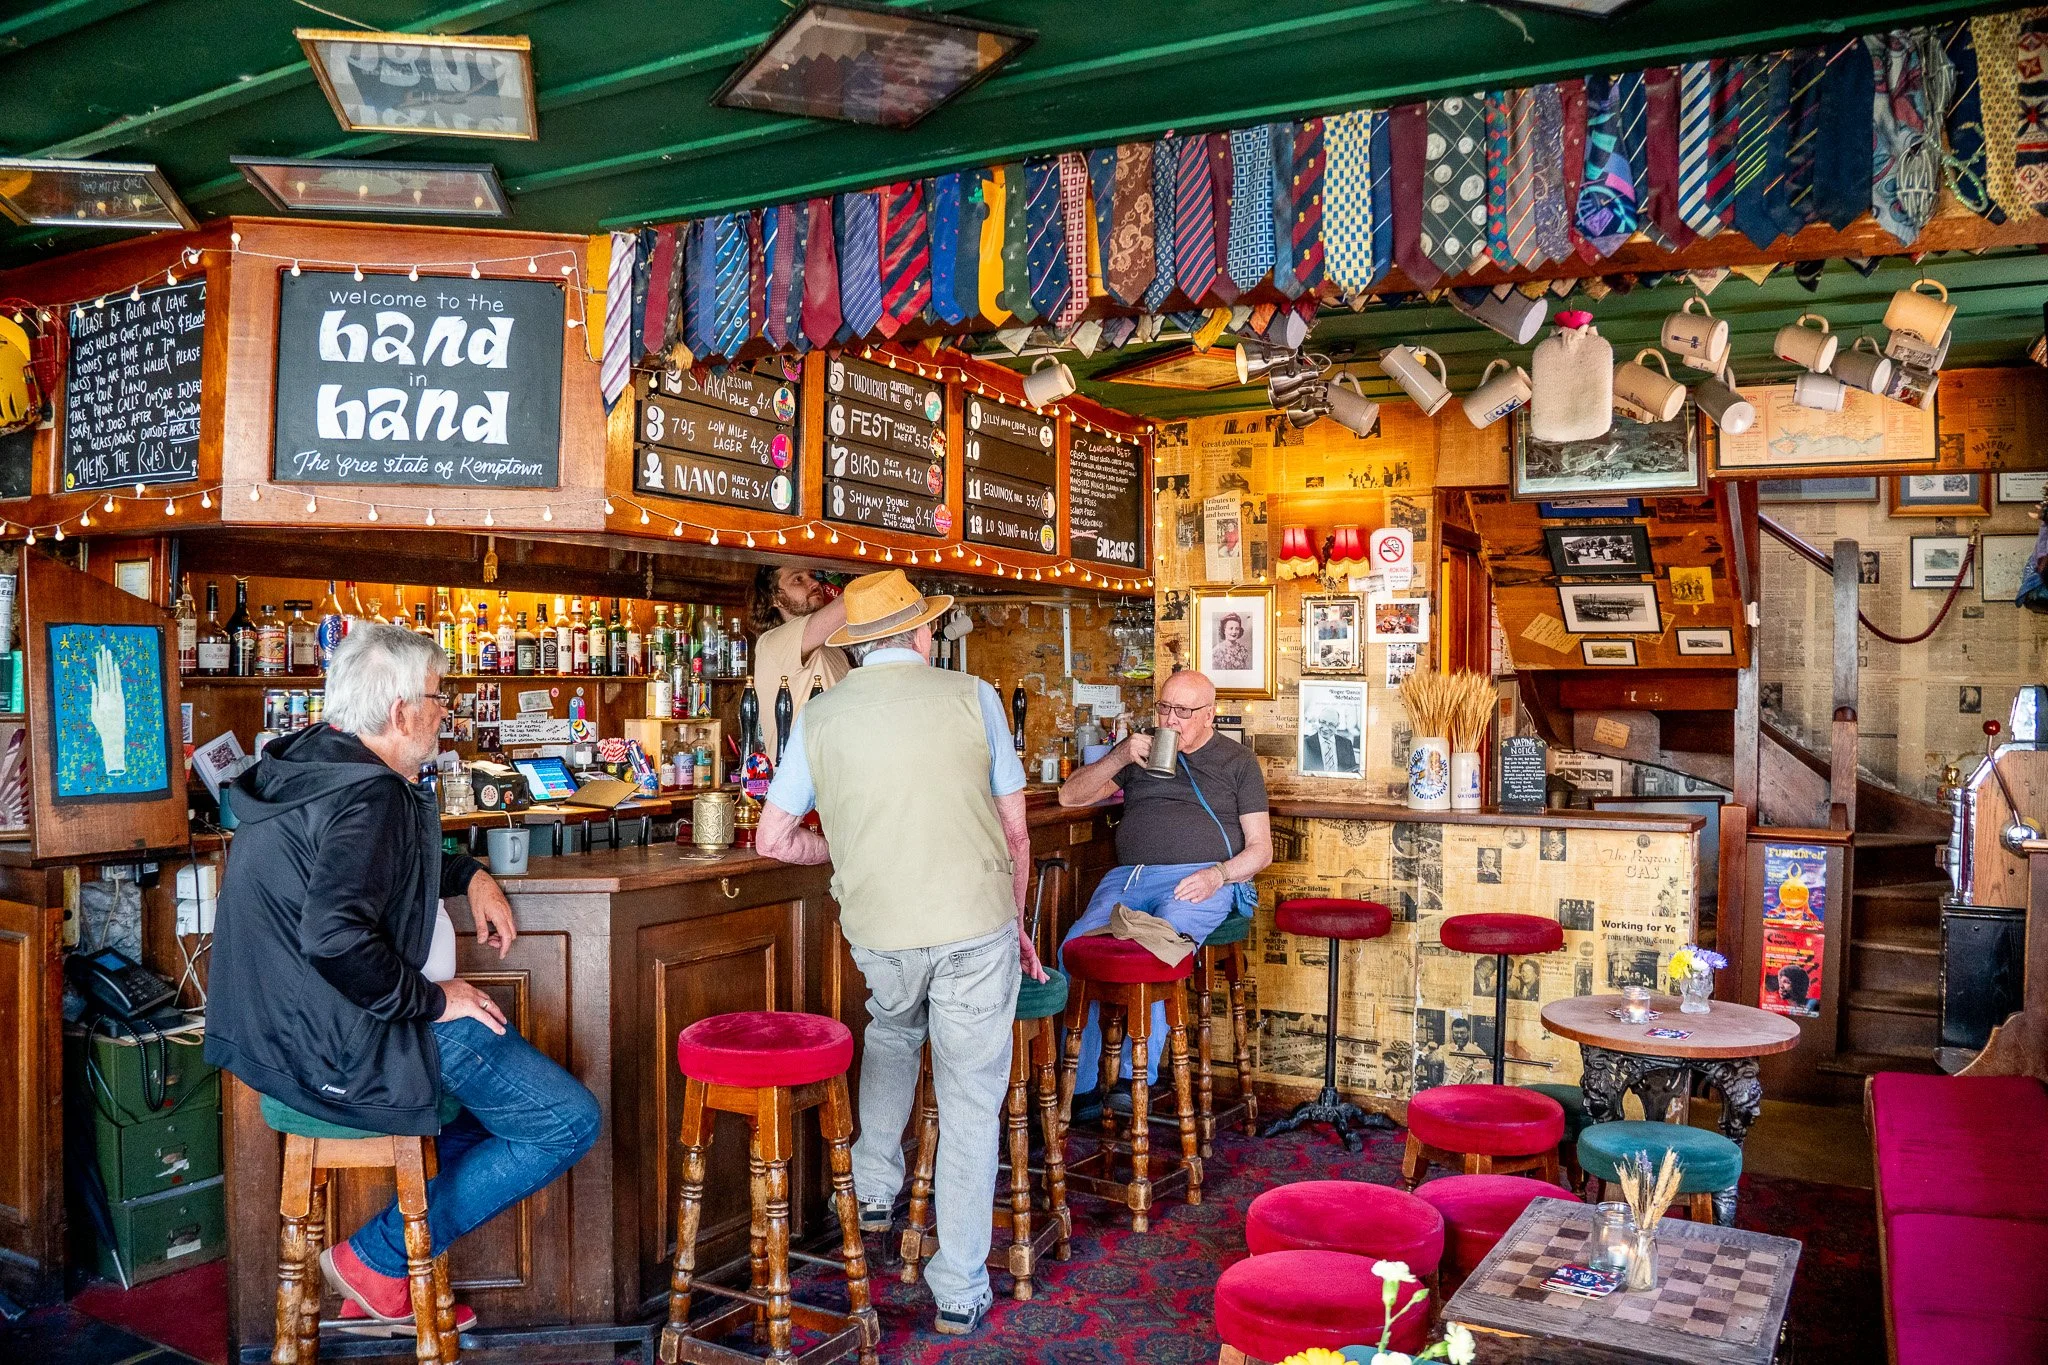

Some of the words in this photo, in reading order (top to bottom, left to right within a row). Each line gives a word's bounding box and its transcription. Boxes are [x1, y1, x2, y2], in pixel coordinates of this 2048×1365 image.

[330, 290, 427, 308] welcome
[437, 292, 460, 310] to
[467, 293, 504, 313] the
[78, 312, 103, 338] PLEASE
[110, 308, 120, 327] BE
[126, 302, 146, 323] POLITE
[152, 296, 163, 320] OR
[166, 294, 188, 312] LEAVE
[76, 341, 94, 361] DOGS
[153, 316, 174, 335] LEADS
[318, 310, 515, 368] hand
[70, 376, 91, 393] UNLESS
[108, 369, 119, 383] ARE
[124, 364, 140, 379] FATS
[143, 354, 171, 374] WALLER
[176, 346, 200, 366] PLEASE
[77, 355, 102, 375] KIDDIES
[107, 352, 117, 365] GO
[121, 344, 138, 365] HOME
[145, 342, 154, 356] AT
[409, 372, 427, 387] in
[727, 375, 753, 391] SESSION
[830, 361, 844, 392] 5
[70, 395, 80, 408] GET
[84, 392, 95, 404] OFF
[97, 385, 113, 402] OUR
[120, 380, 147, 397] PIANO
[70, 409, 87, 423] TAKE
[93, 403, 113, 418] PHONE
[118, 394, 139, 413] CALLS
[145, 387, 173, 408] OUTSIDE
[729, 393, 749, 407] PALE
[95, 419, 104, 433] NO
[106, 416, 126, 432] DOGS
[131, 411, 152, 427] AFTER
[317, 384, 510, 445] hand
[646, 405, 665, 441] 3
[671, 418, 696, 441] 795
[708, 420, 725, 437] LOW
[728, 424, 748, 440] MILE
[830, 404, 845, 436] 6
[850, 408, 894, 441] FEST
[970, 401, 982, 430] 9
[982, 412, 1000, 427] SILLY
[1011, 420, 1027, 432] CIDER
[73, 441, 82, 455] NO
[141, 426, 168, 440] OUTSIDE
[169, 422, 188, 436] AFTER
[713, 437, 743, 453] LAGER
[893, 430, 913, 443] LAGER
[1202, 441, 1221, 449] Great
[1221, 438, 1253, 449] gobblers!
[112, 449, 130, 473] THE
[138, 442, 165, 473] RULES
[831, 443, 848, 477] 7
[850, 452, 880, 478] BIRD
[884, 458, 900, 468] BEST
[965, 439, 980, 461] 10
[293, 450, 329, 475] The
[434, 457, 453, 479] of
[459, 456, 543, 482] Kemptown
[643, 452, 664, 489] 4
[674, 464, 728, 496] NANO
[731, 474, 750, 487] HAZY
[752, 480, 769, 501] 3%
[882, 467, 903, 479] BITTER
[731, 487, 750, 500] PALE
[833, 485, 845, 517] 8
[849, 490, 883, 510] SHIMMY
[885, 495, 909, 508] DOUBLE
[968, 478, 981, 500] 11
[983, 482, 1014, 502] EQUINOX
[857, 507, 871, 520] UP
[886, 505, 900, 514] IPA
[1205, 504, 1230, 512] landlord
[969, 515, 983, 535] 12
[985, 518, 995, 533] LO
[997, 520, 1019, 538] SLUNG
[1329, 688, 1344, 696] Roger
[1510, 746, 1537, 755] NOTICE
[1512, 737, 1536, 748] VAPING
[748, 780, 763, 788] HIGH
[1601, 920, 1643, 932] Working
[1647, 923, 1661, 932] for
[1622, 933, 1633, 942] the
